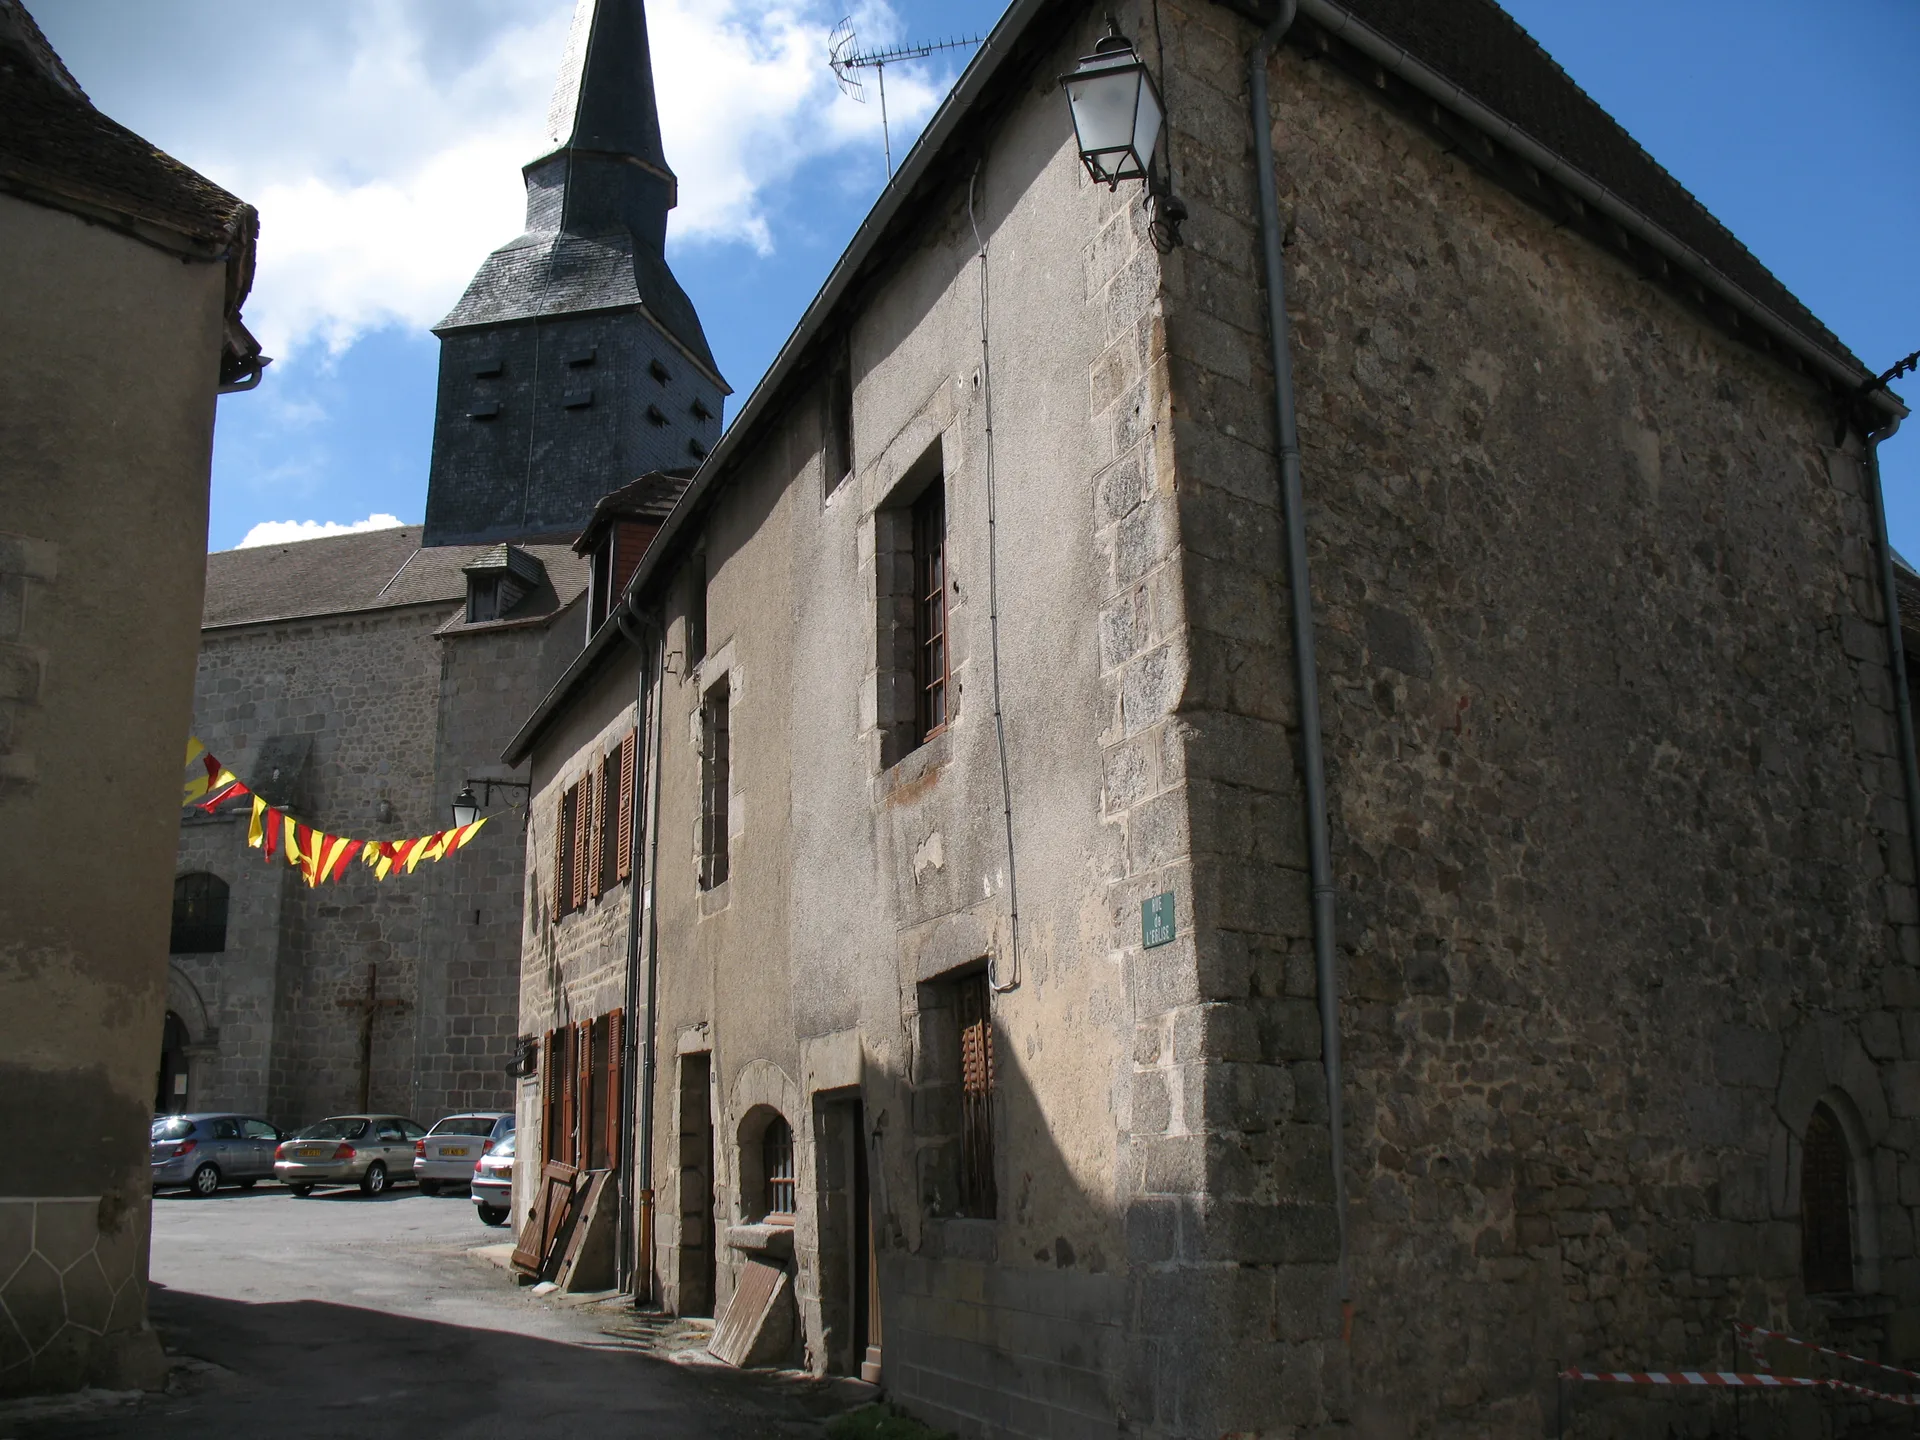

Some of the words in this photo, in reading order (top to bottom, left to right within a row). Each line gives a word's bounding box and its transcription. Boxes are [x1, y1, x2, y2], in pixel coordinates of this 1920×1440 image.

[1151, 896, 1162, 912] RUE
[1154, 913, 1162, 928] de
[1146, 925, 1169, 945] L'EGLISE
